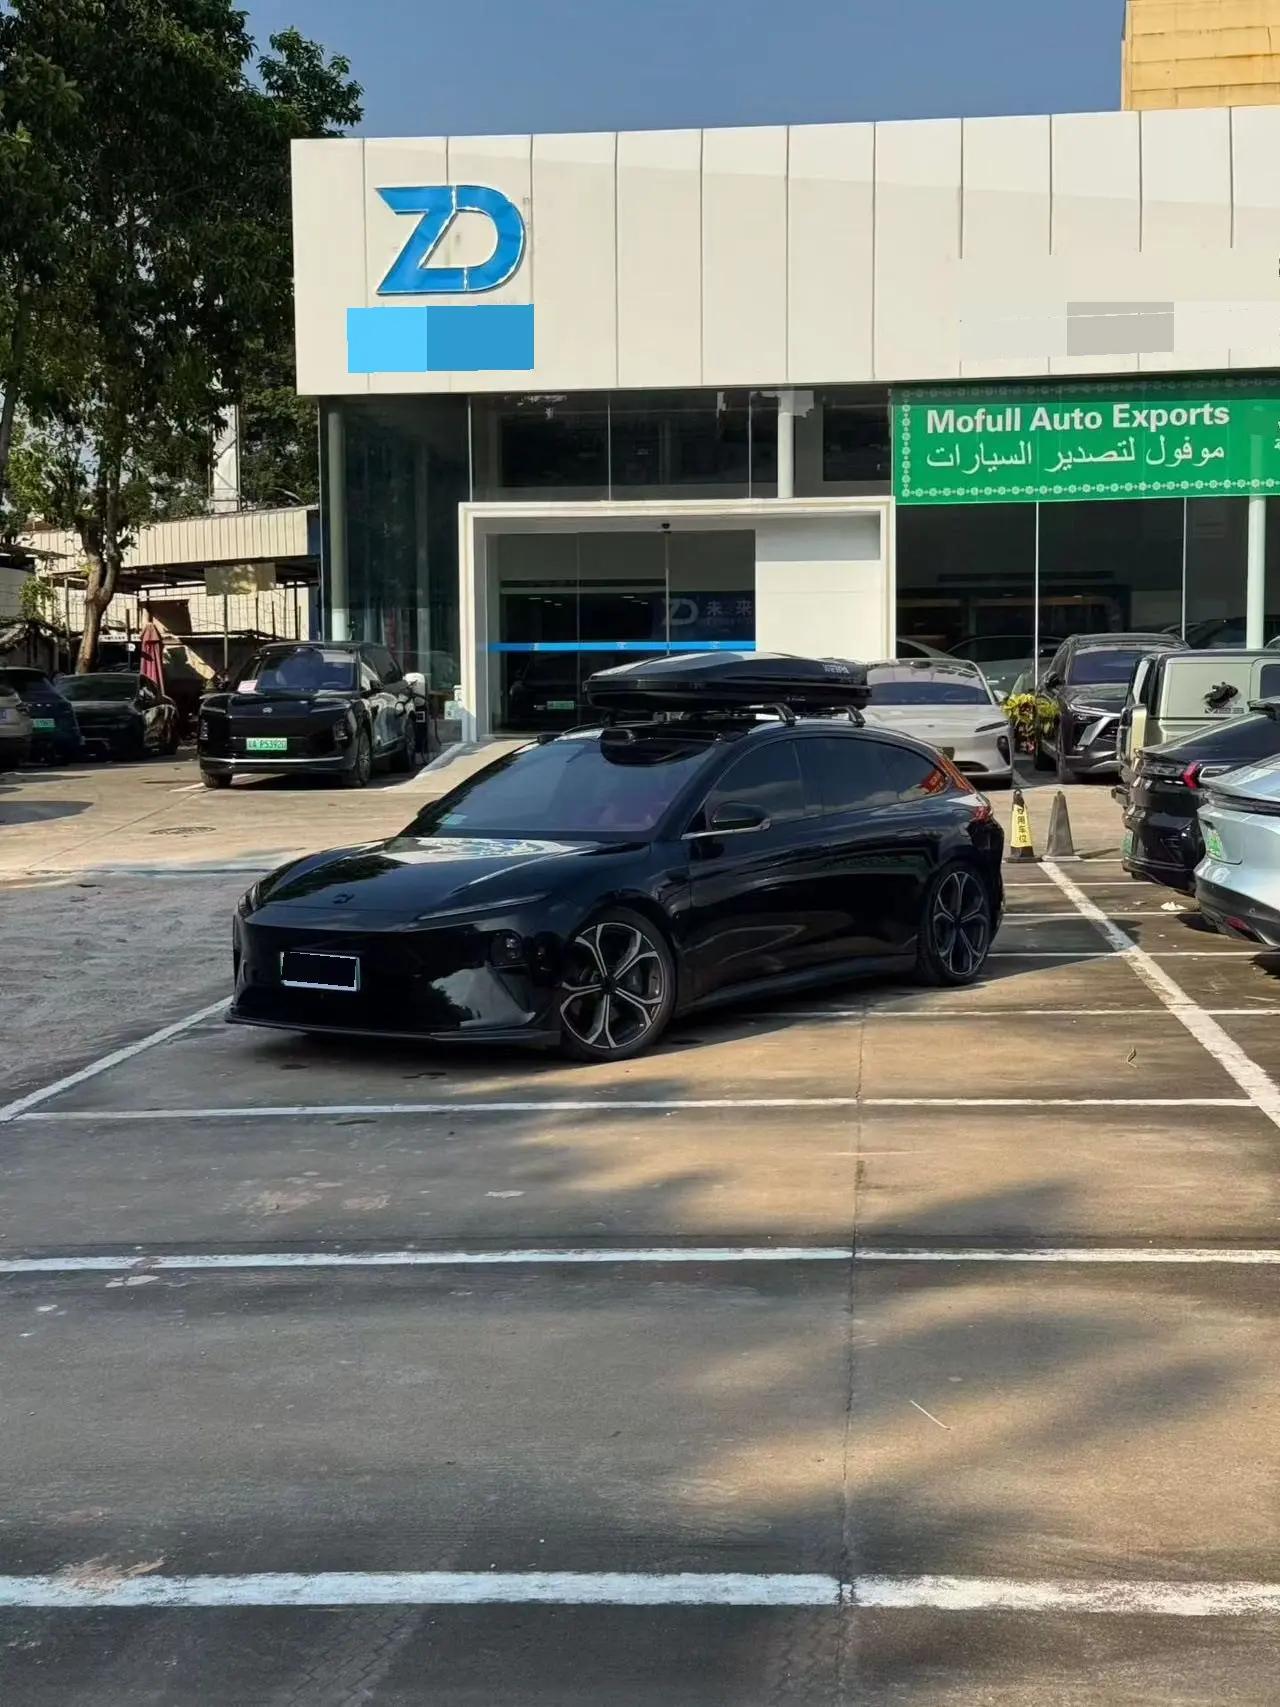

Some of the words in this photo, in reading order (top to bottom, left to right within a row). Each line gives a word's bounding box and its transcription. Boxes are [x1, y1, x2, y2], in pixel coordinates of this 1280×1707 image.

[374, 184, 527, 296] ZD
[926, 407, 1021, 434] Mofull
[1028, 406, 1103, 432] Auto
[1112, 403, 1230, 433] Exports
[926, 440, 1032, 475] السيارات
[1044, 436, 1136, 473] لتصدير
[1146, 435, 1224, 467] موفول
